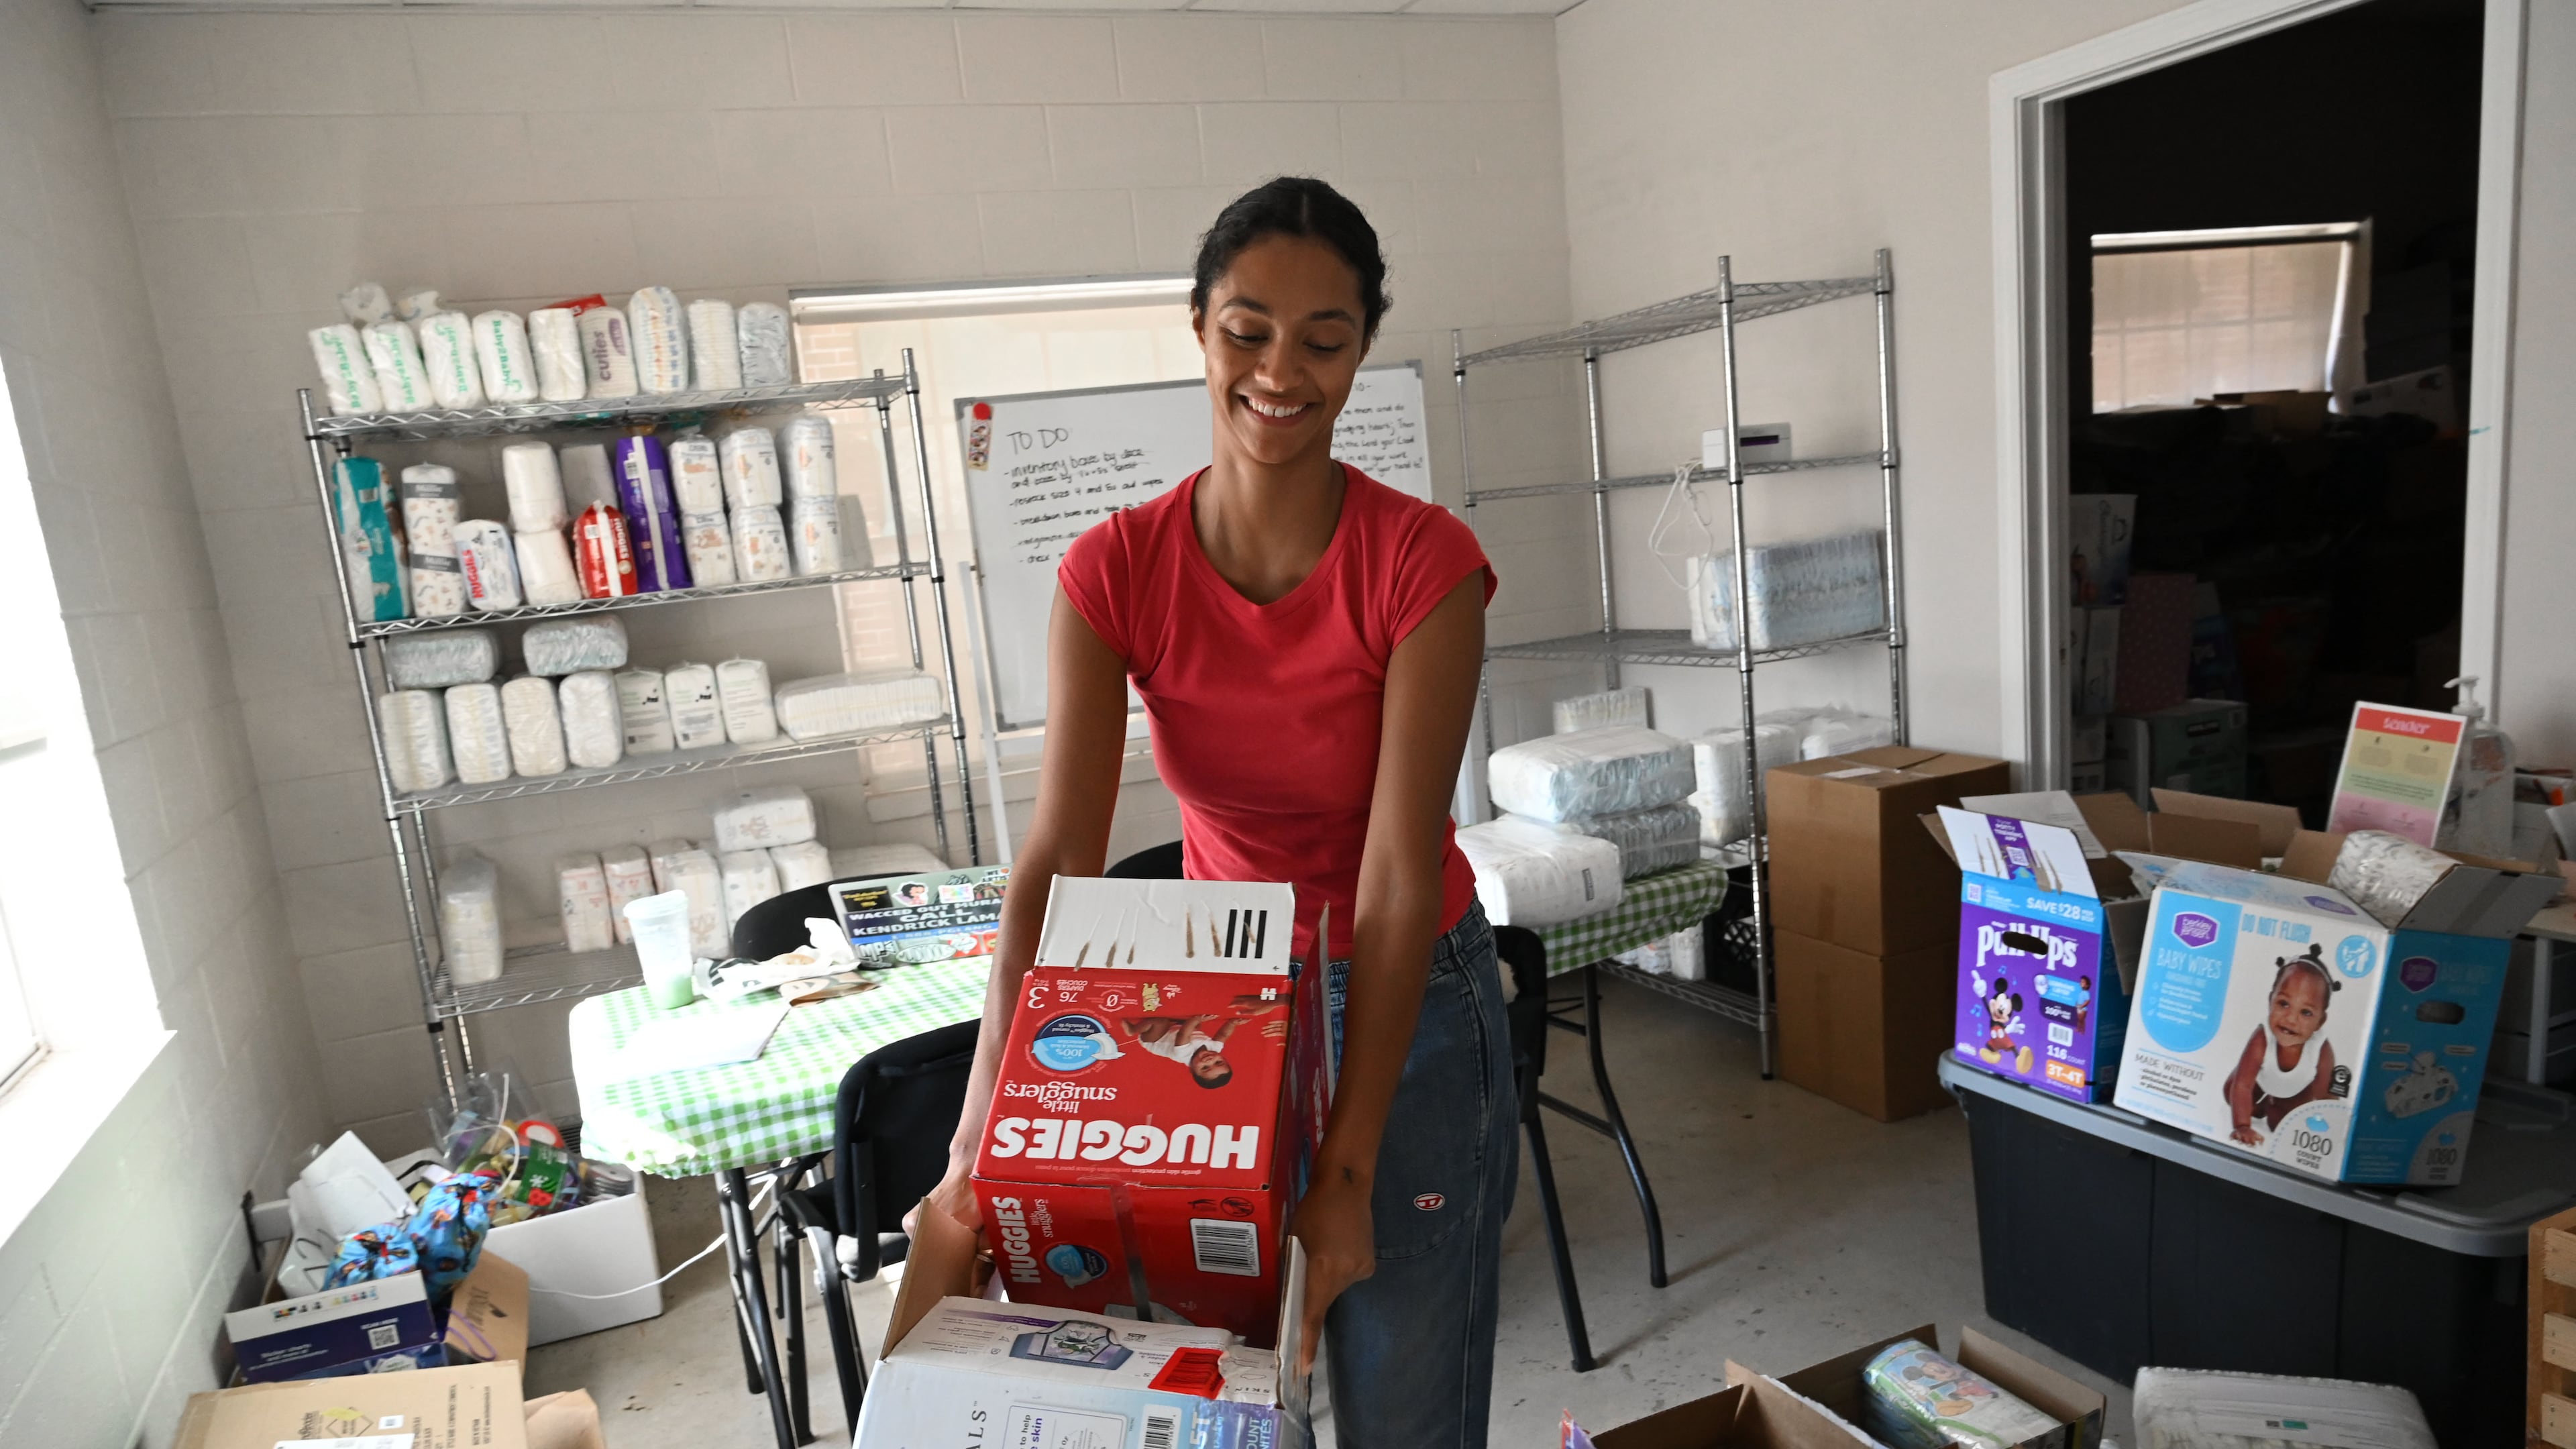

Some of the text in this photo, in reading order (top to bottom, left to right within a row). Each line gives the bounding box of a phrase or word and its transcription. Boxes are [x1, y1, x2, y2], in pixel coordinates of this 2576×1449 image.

[592, 331, 612, 380] cuties
[1007, 428, 1069, 455] TO DO
[613, 517, 629, 559] HUGGIES
[462, 549, 485, 598] HUGGIES
[848, 898, 1004, 921] WACCED OUT MURA
[900, 909, 973, 923] CALL
[2026, 897, 2057, 914] SAVE
[2059, 903, 2081, 919] $28
[853, 911, 1000, 936] KENDRICK LAMA
[2241, 913, 2312, 945] DO NOT FLUSH
[1976, 922, 2080, 971] PullUps
[2156, 948, 2186, 969] BABY
[2188, 954, 2222, 979] WIPES
[1027, 986, 1049, 1009] 3
[1059, 991, 1078, 1003] 76
[1055, 1049, 1083, 1057] 100%
[2047, 1044, 2068, 1060] 116
[2134, 1053, 2206, 1081] MADE WITHOUT
[1003, 1081, 1118, 1105] snugglers
[1042, 1099, 1081, 1114] little
[990, 1116, 1260, 1170] HUGGIES
[2292, 1129, 2332, 1157] 1080
[2296, 1149, 2322, 1163] COUNT
[2295, 1157, 2320, 1170] WIPES
[1034, 1199, 1054, 1238] snugglers
[991, 1196, 1042, 1283] HUGGIES
[1020, 1414, 1032, 1446] to help
[1031, 1417, 1043, 1442] skin
